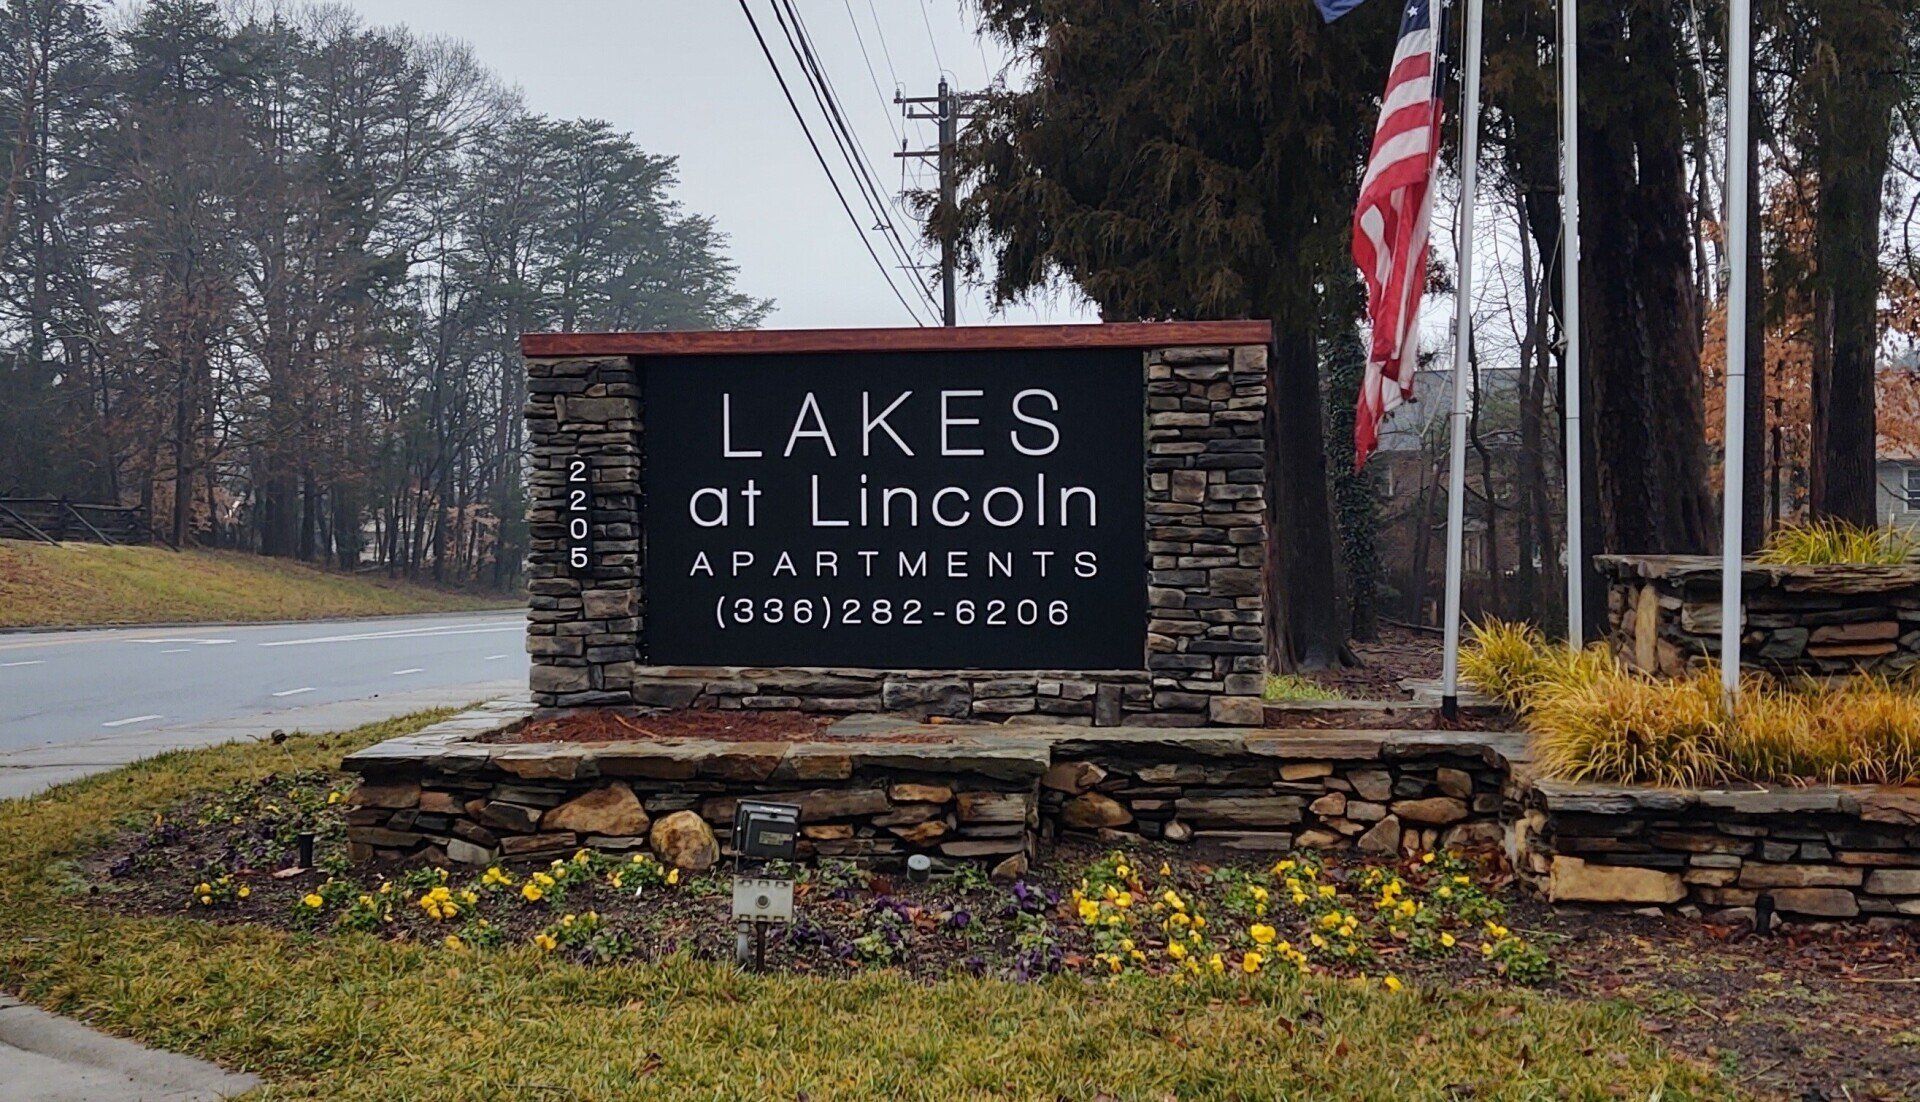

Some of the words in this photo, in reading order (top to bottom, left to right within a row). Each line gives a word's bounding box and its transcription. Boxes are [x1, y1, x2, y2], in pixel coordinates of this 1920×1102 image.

[723, 389, 1060, 458] LAKES
[569, 460, 588, 569] 2205
[689, 479, 762, 527] at
[812, 473, 1096, 527] Lincoln
[689, 550, 1097, 578] APARTMENTS
[716, 595, 1068, 629] (336)282-6206
